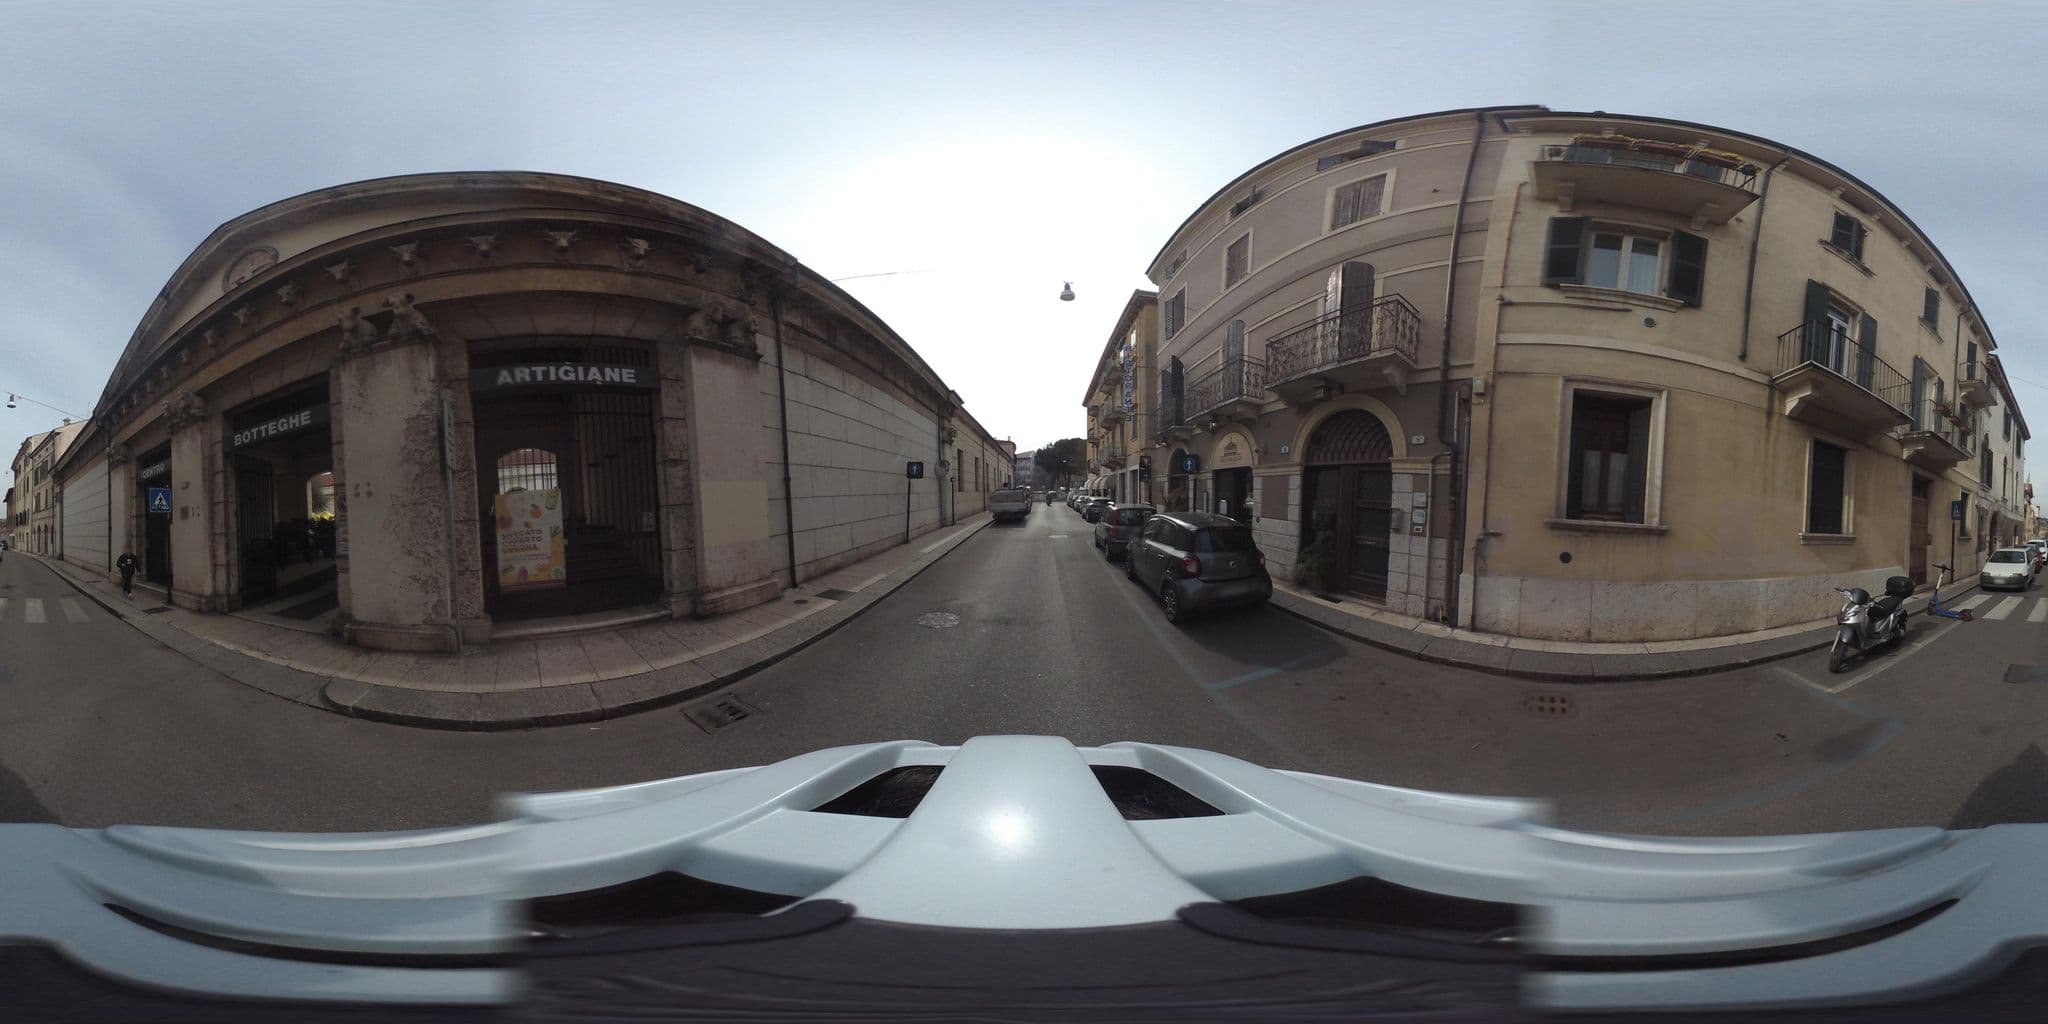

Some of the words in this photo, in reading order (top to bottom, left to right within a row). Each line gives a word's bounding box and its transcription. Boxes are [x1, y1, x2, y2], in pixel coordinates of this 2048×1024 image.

[497, 365, 636, 384] ARTIGIANE
[234, 410, 311, 447] BOTTEGHE
[142, 463, 165, 479] CENTRO
